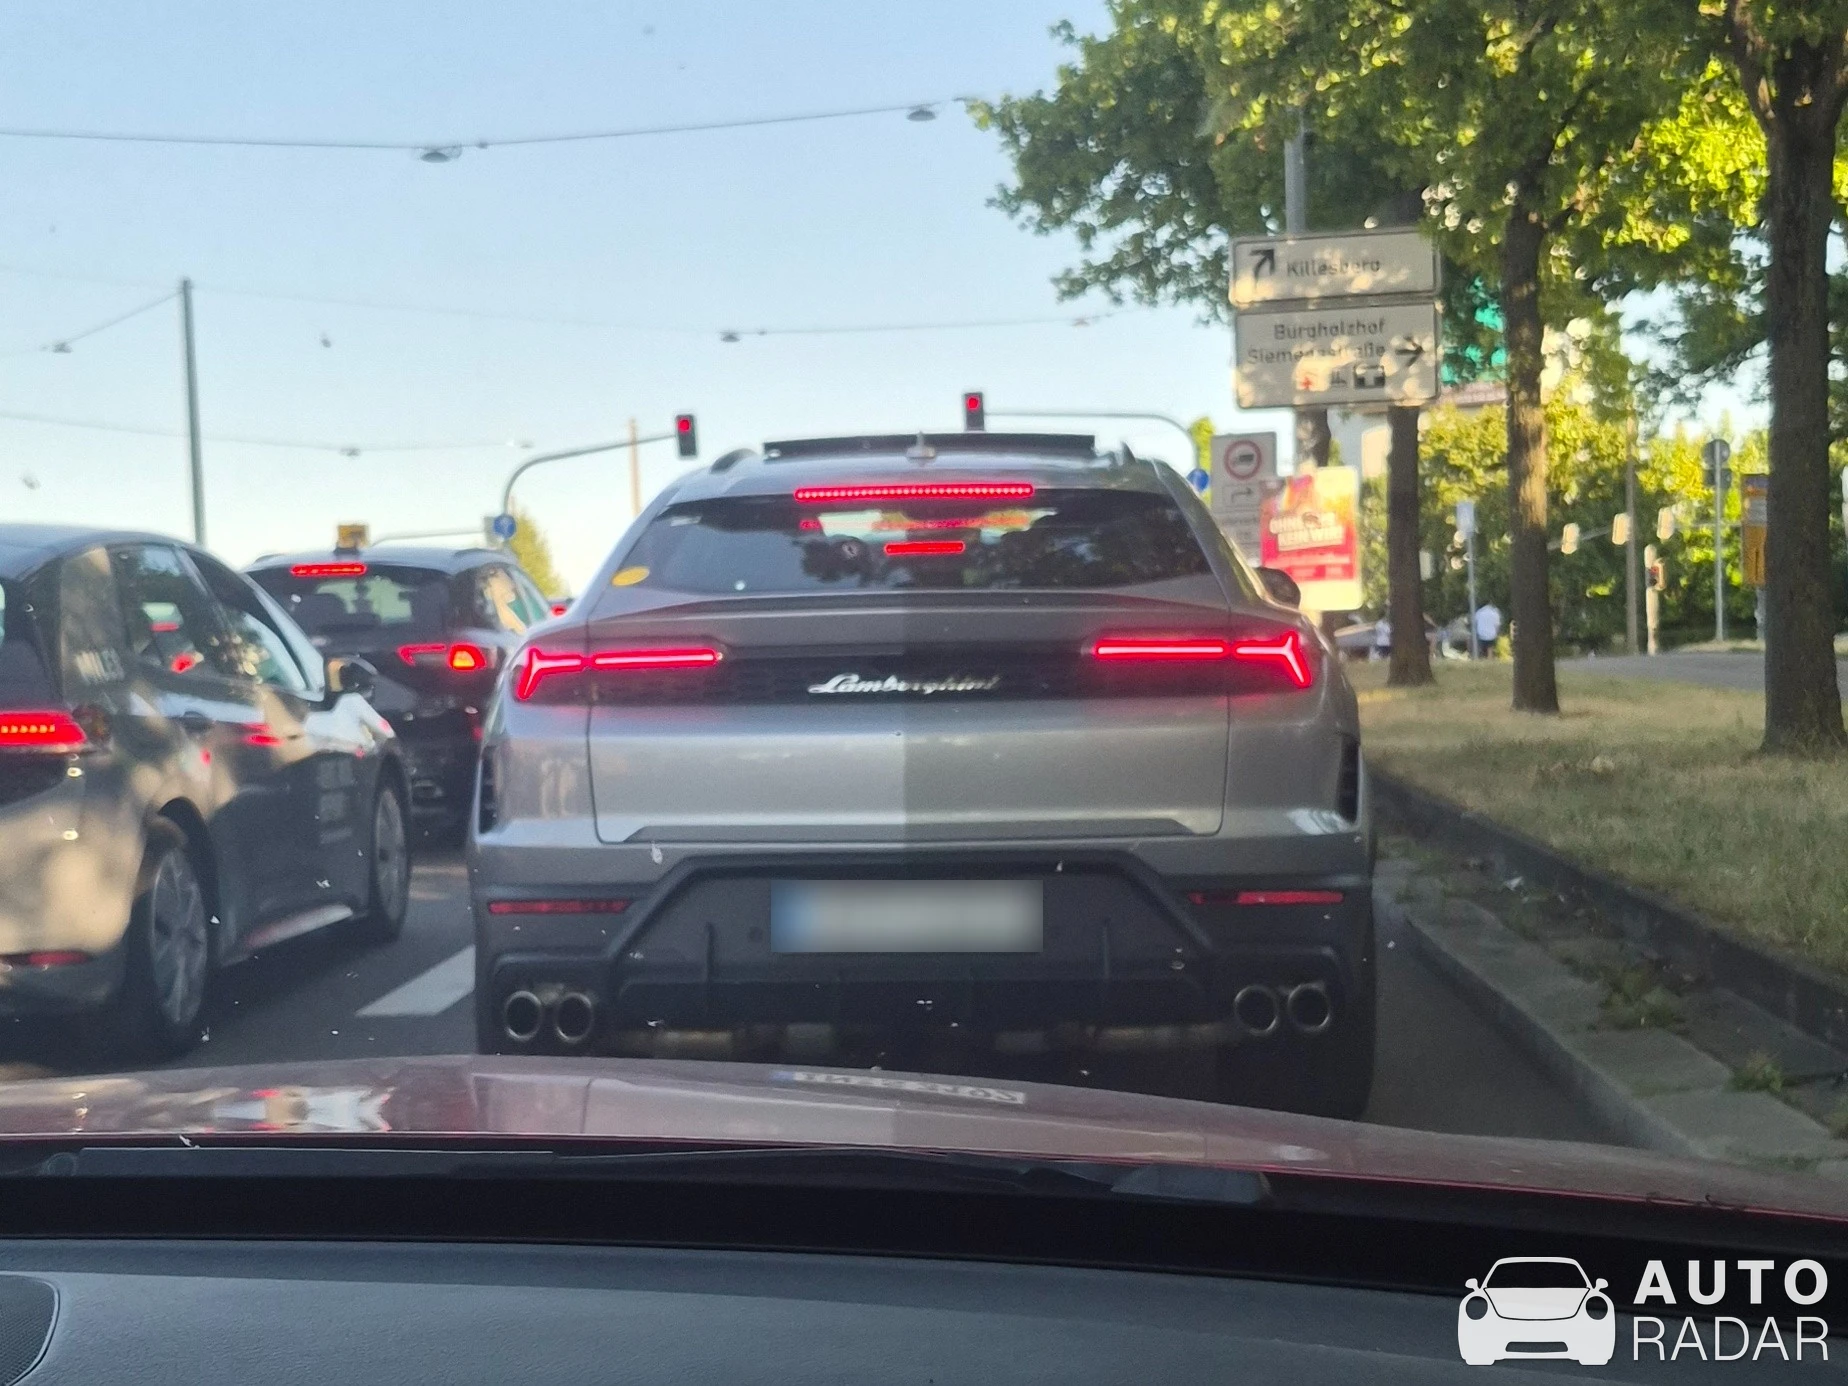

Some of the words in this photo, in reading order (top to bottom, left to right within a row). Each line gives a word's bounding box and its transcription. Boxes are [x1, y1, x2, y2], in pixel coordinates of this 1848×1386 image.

[1273, 317, 1386, 341] Burgholzhof
[1247, 342, 1386, 364] Siemenssaße
[808, 673, 1000, 694] Lamborghini
